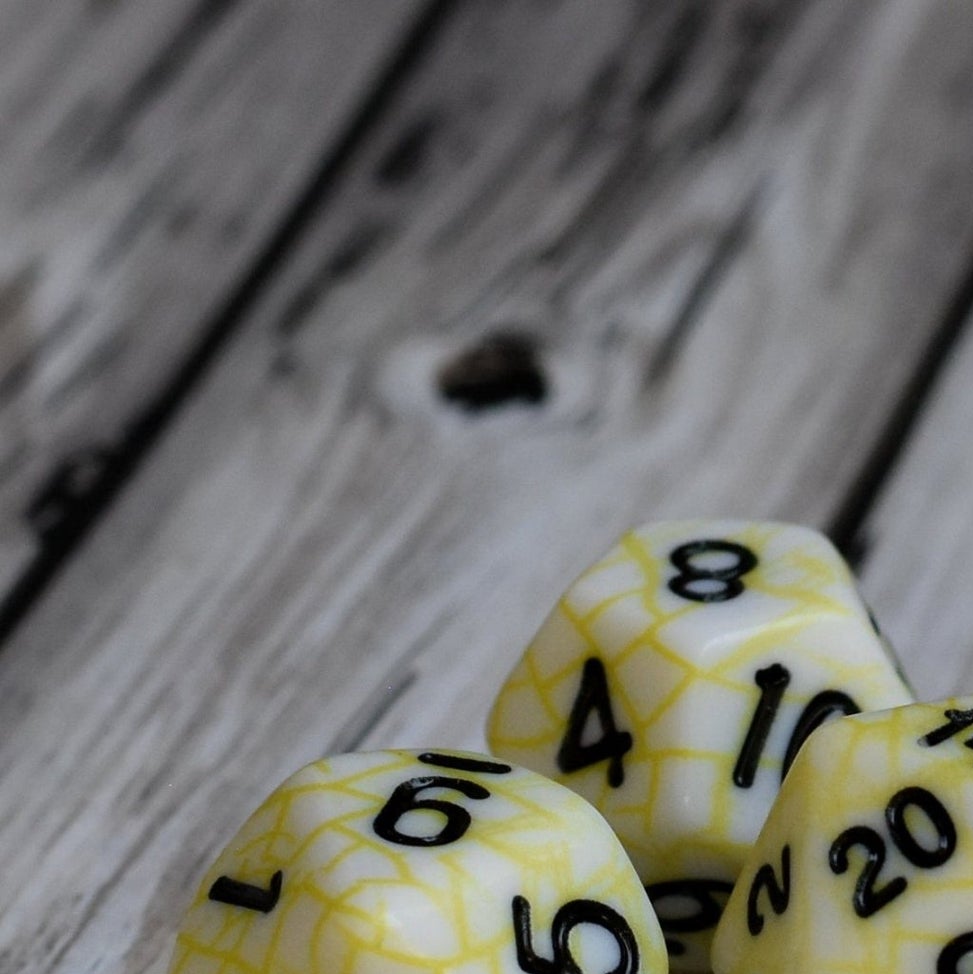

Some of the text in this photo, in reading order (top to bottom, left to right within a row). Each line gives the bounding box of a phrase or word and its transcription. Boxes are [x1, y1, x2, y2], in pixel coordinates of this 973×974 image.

[667, 538, 759, 603] 8
[554, 654, 635, 789] 4
[207, 869, 284, 916] 1
[744, 842, 793, 938] 2
[828, 785, 958, 919] 20
